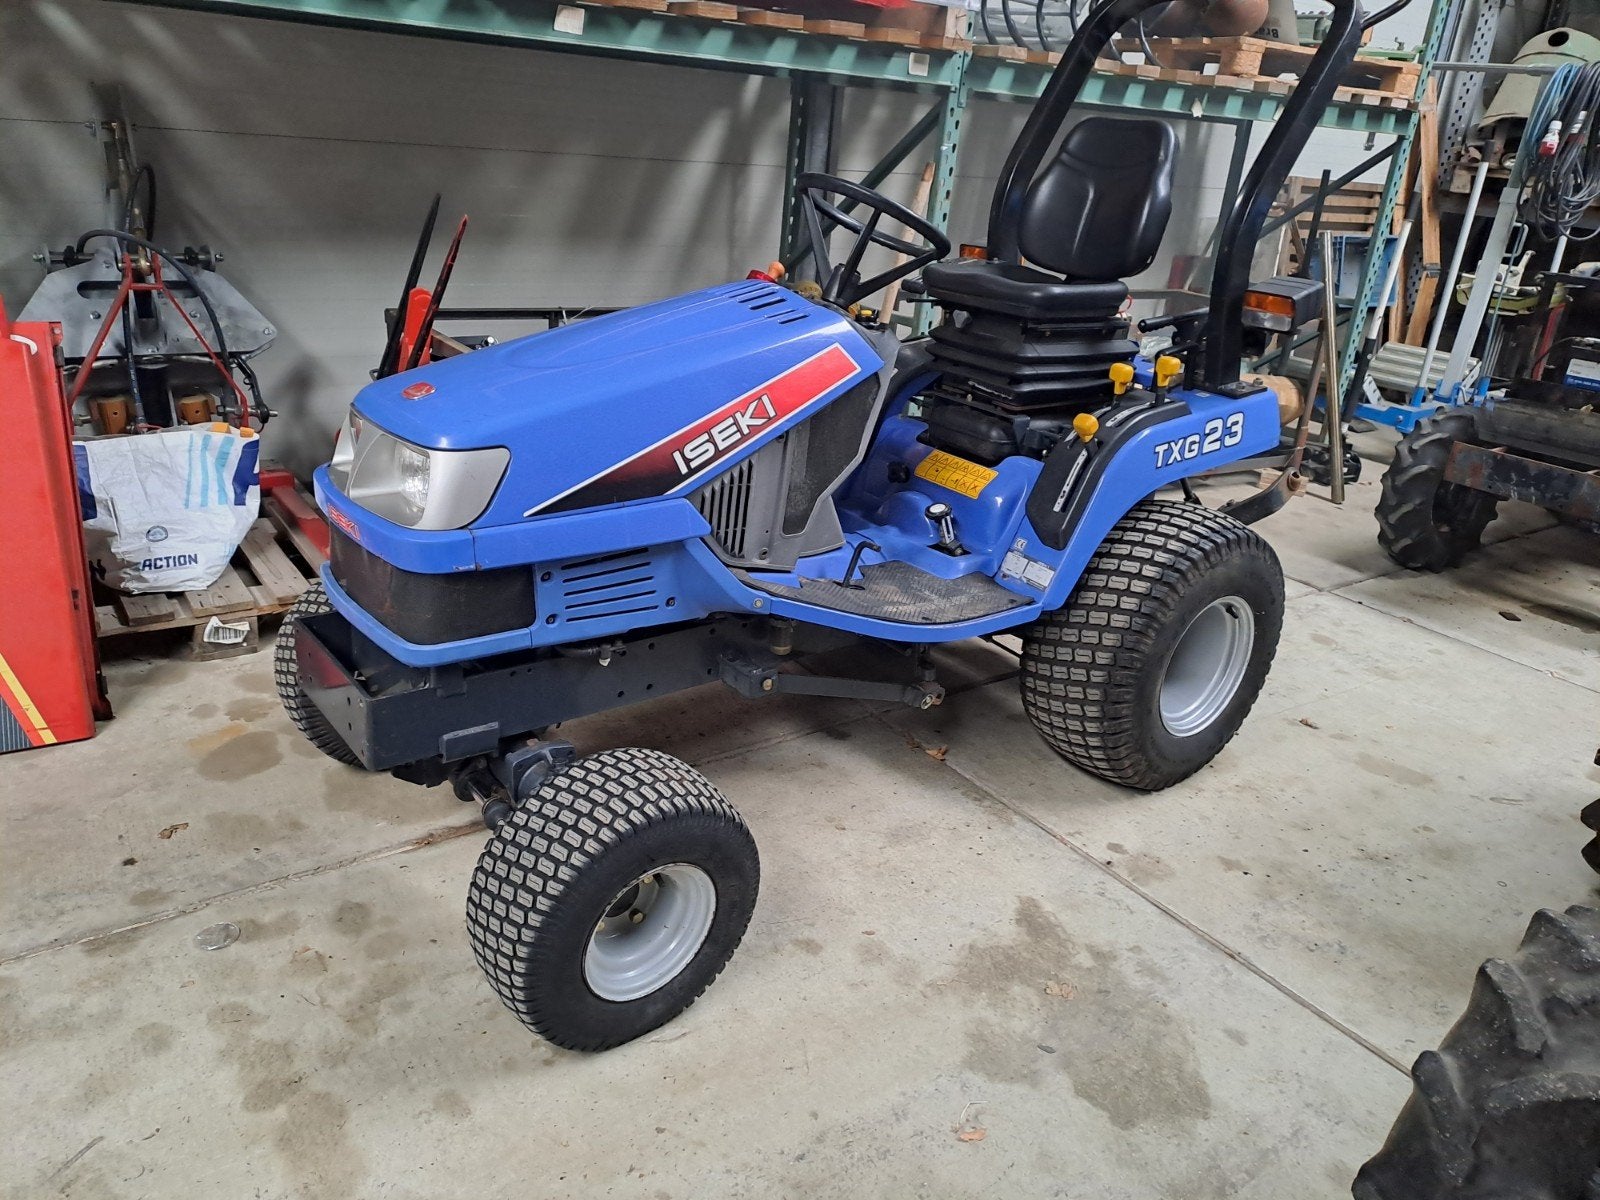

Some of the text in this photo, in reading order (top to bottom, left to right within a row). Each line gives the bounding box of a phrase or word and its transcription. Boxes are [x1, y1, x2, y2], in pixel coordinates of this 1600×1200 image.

[672, 393, 777, 475] ISEKI
[1154, 411, 1245, 469] TXG23
[141, 553, 199, 571] ACTION
